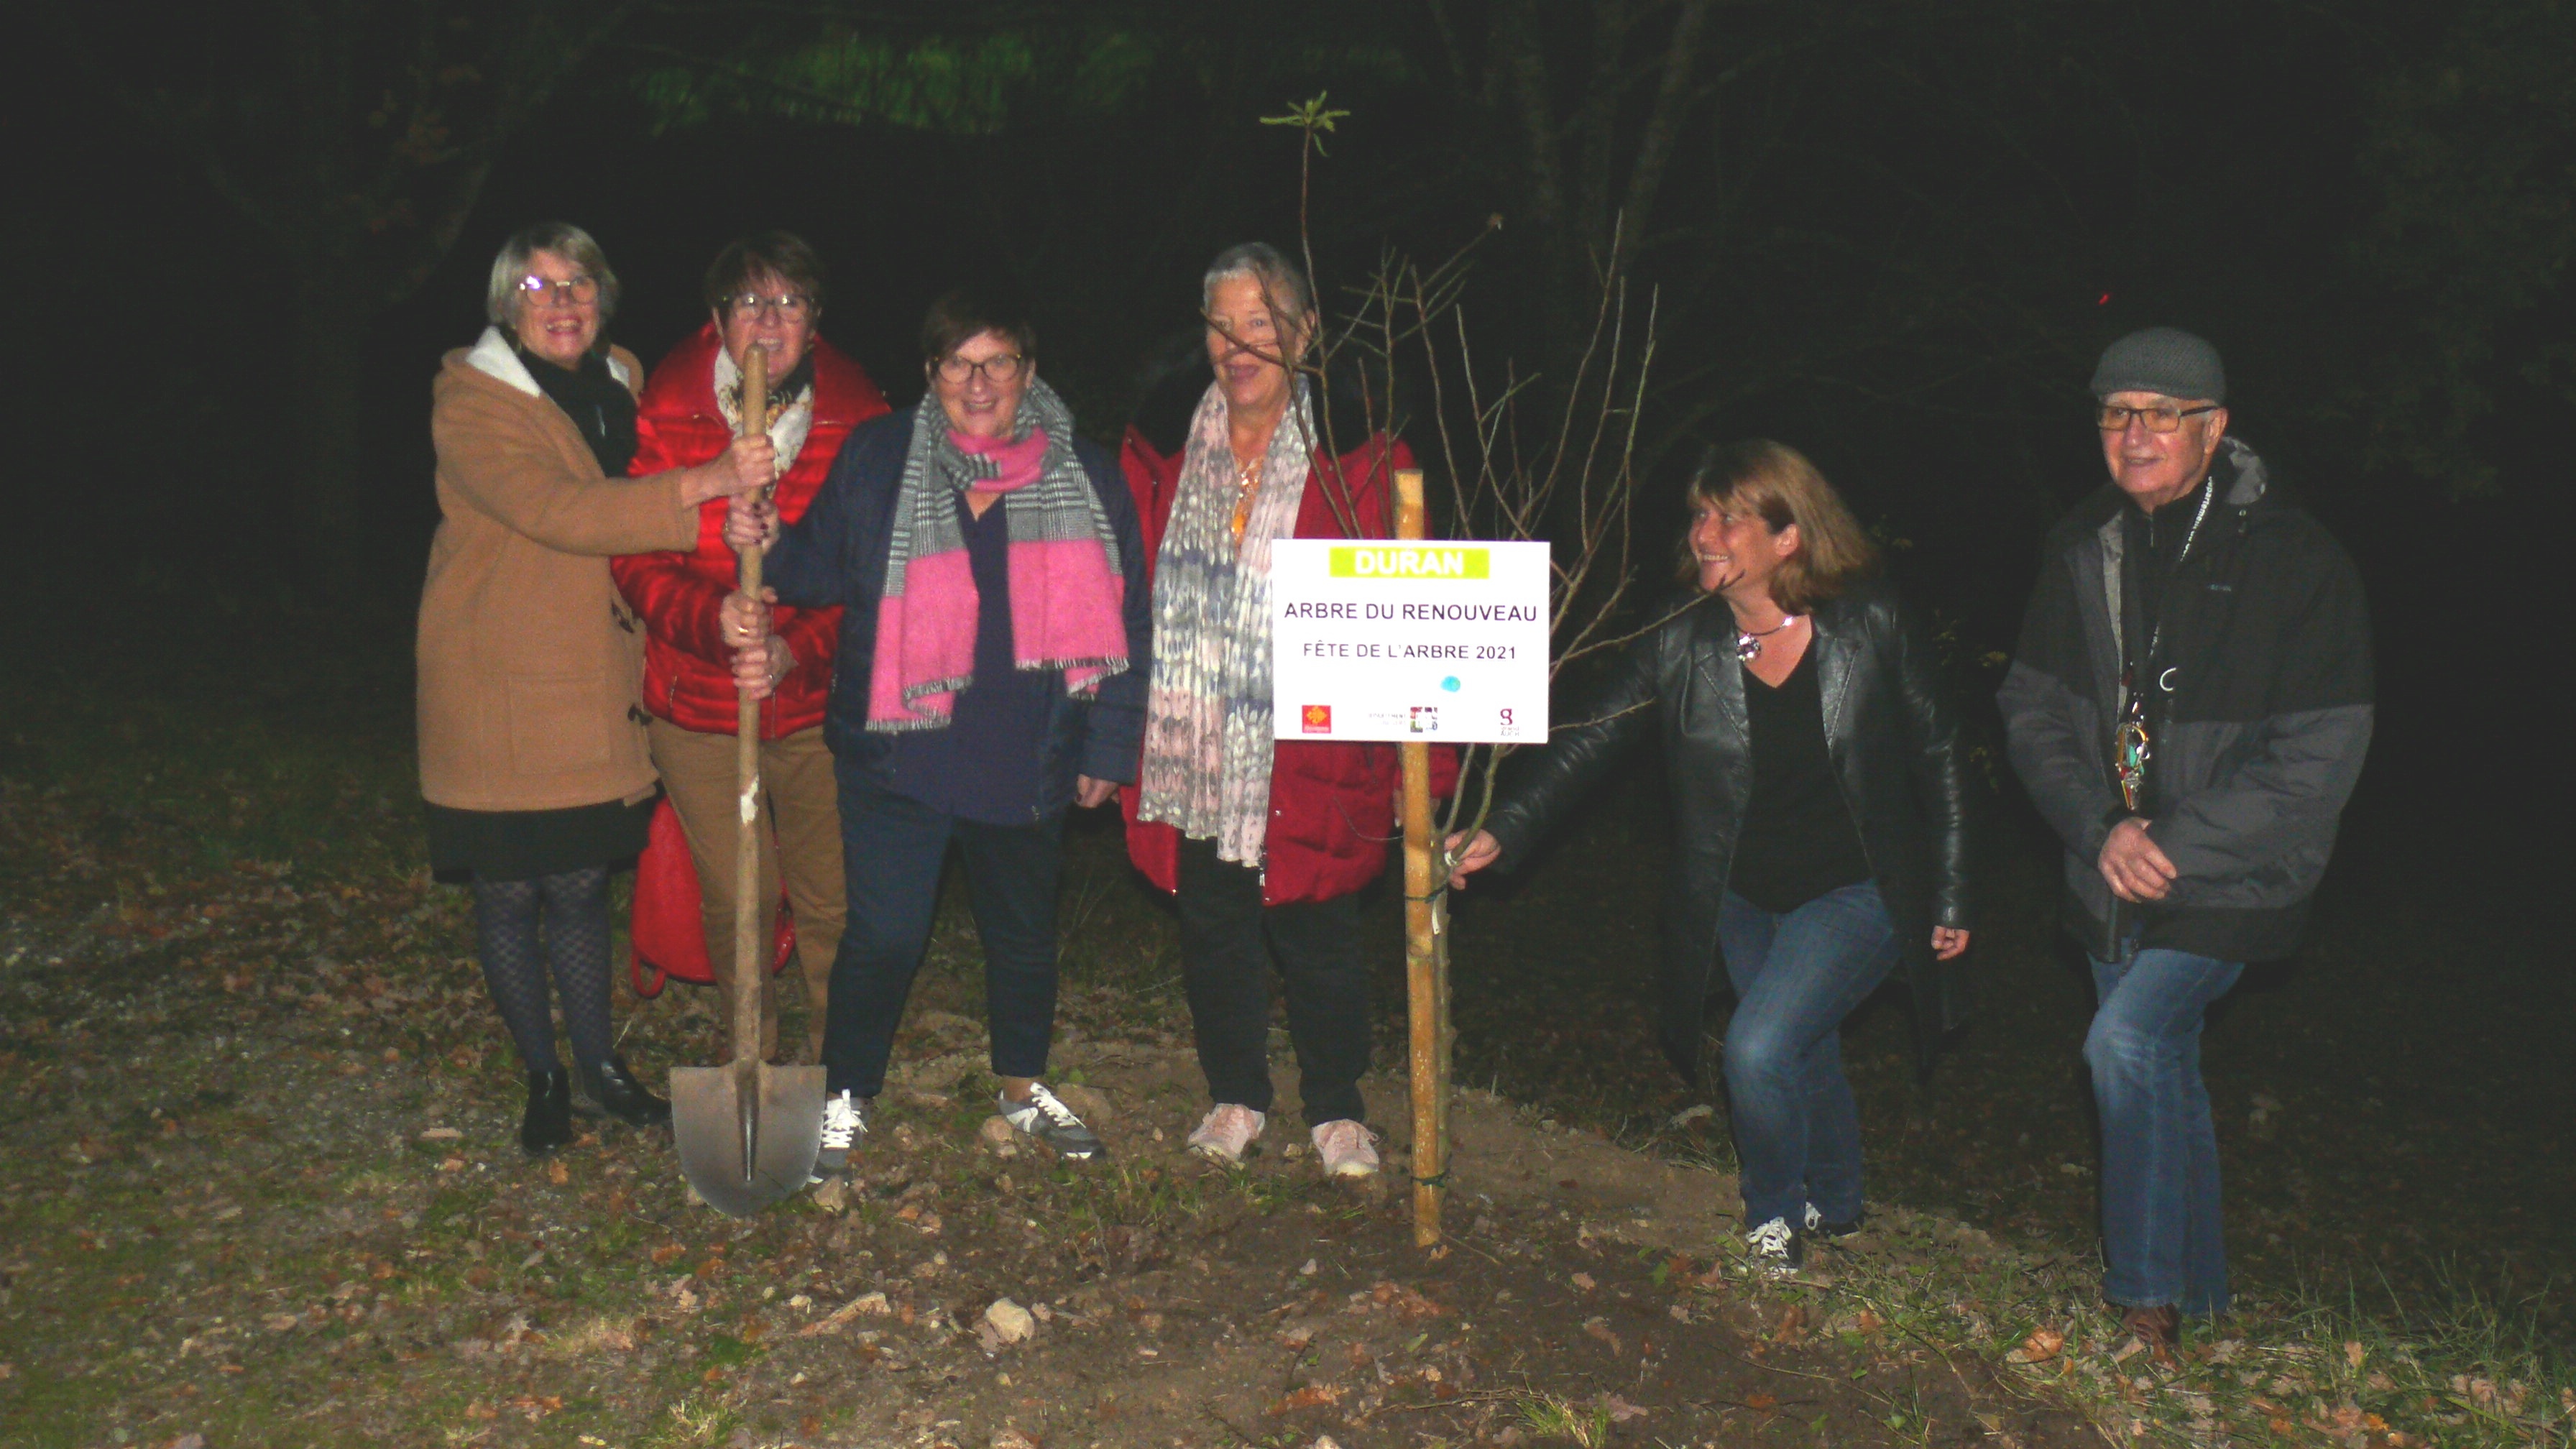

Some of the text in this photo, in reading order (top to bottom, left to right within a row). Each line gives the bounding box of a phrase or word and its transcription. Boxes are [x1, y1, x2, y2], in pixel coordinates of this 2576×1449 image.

[1355, 551, 1463, 574] DURAN
[1284, 602, 1537, 622] ARBRE DU RENOUVEAU
[1304, 640, 1515, 660] FÊTE DE L'ARBRE 2021
